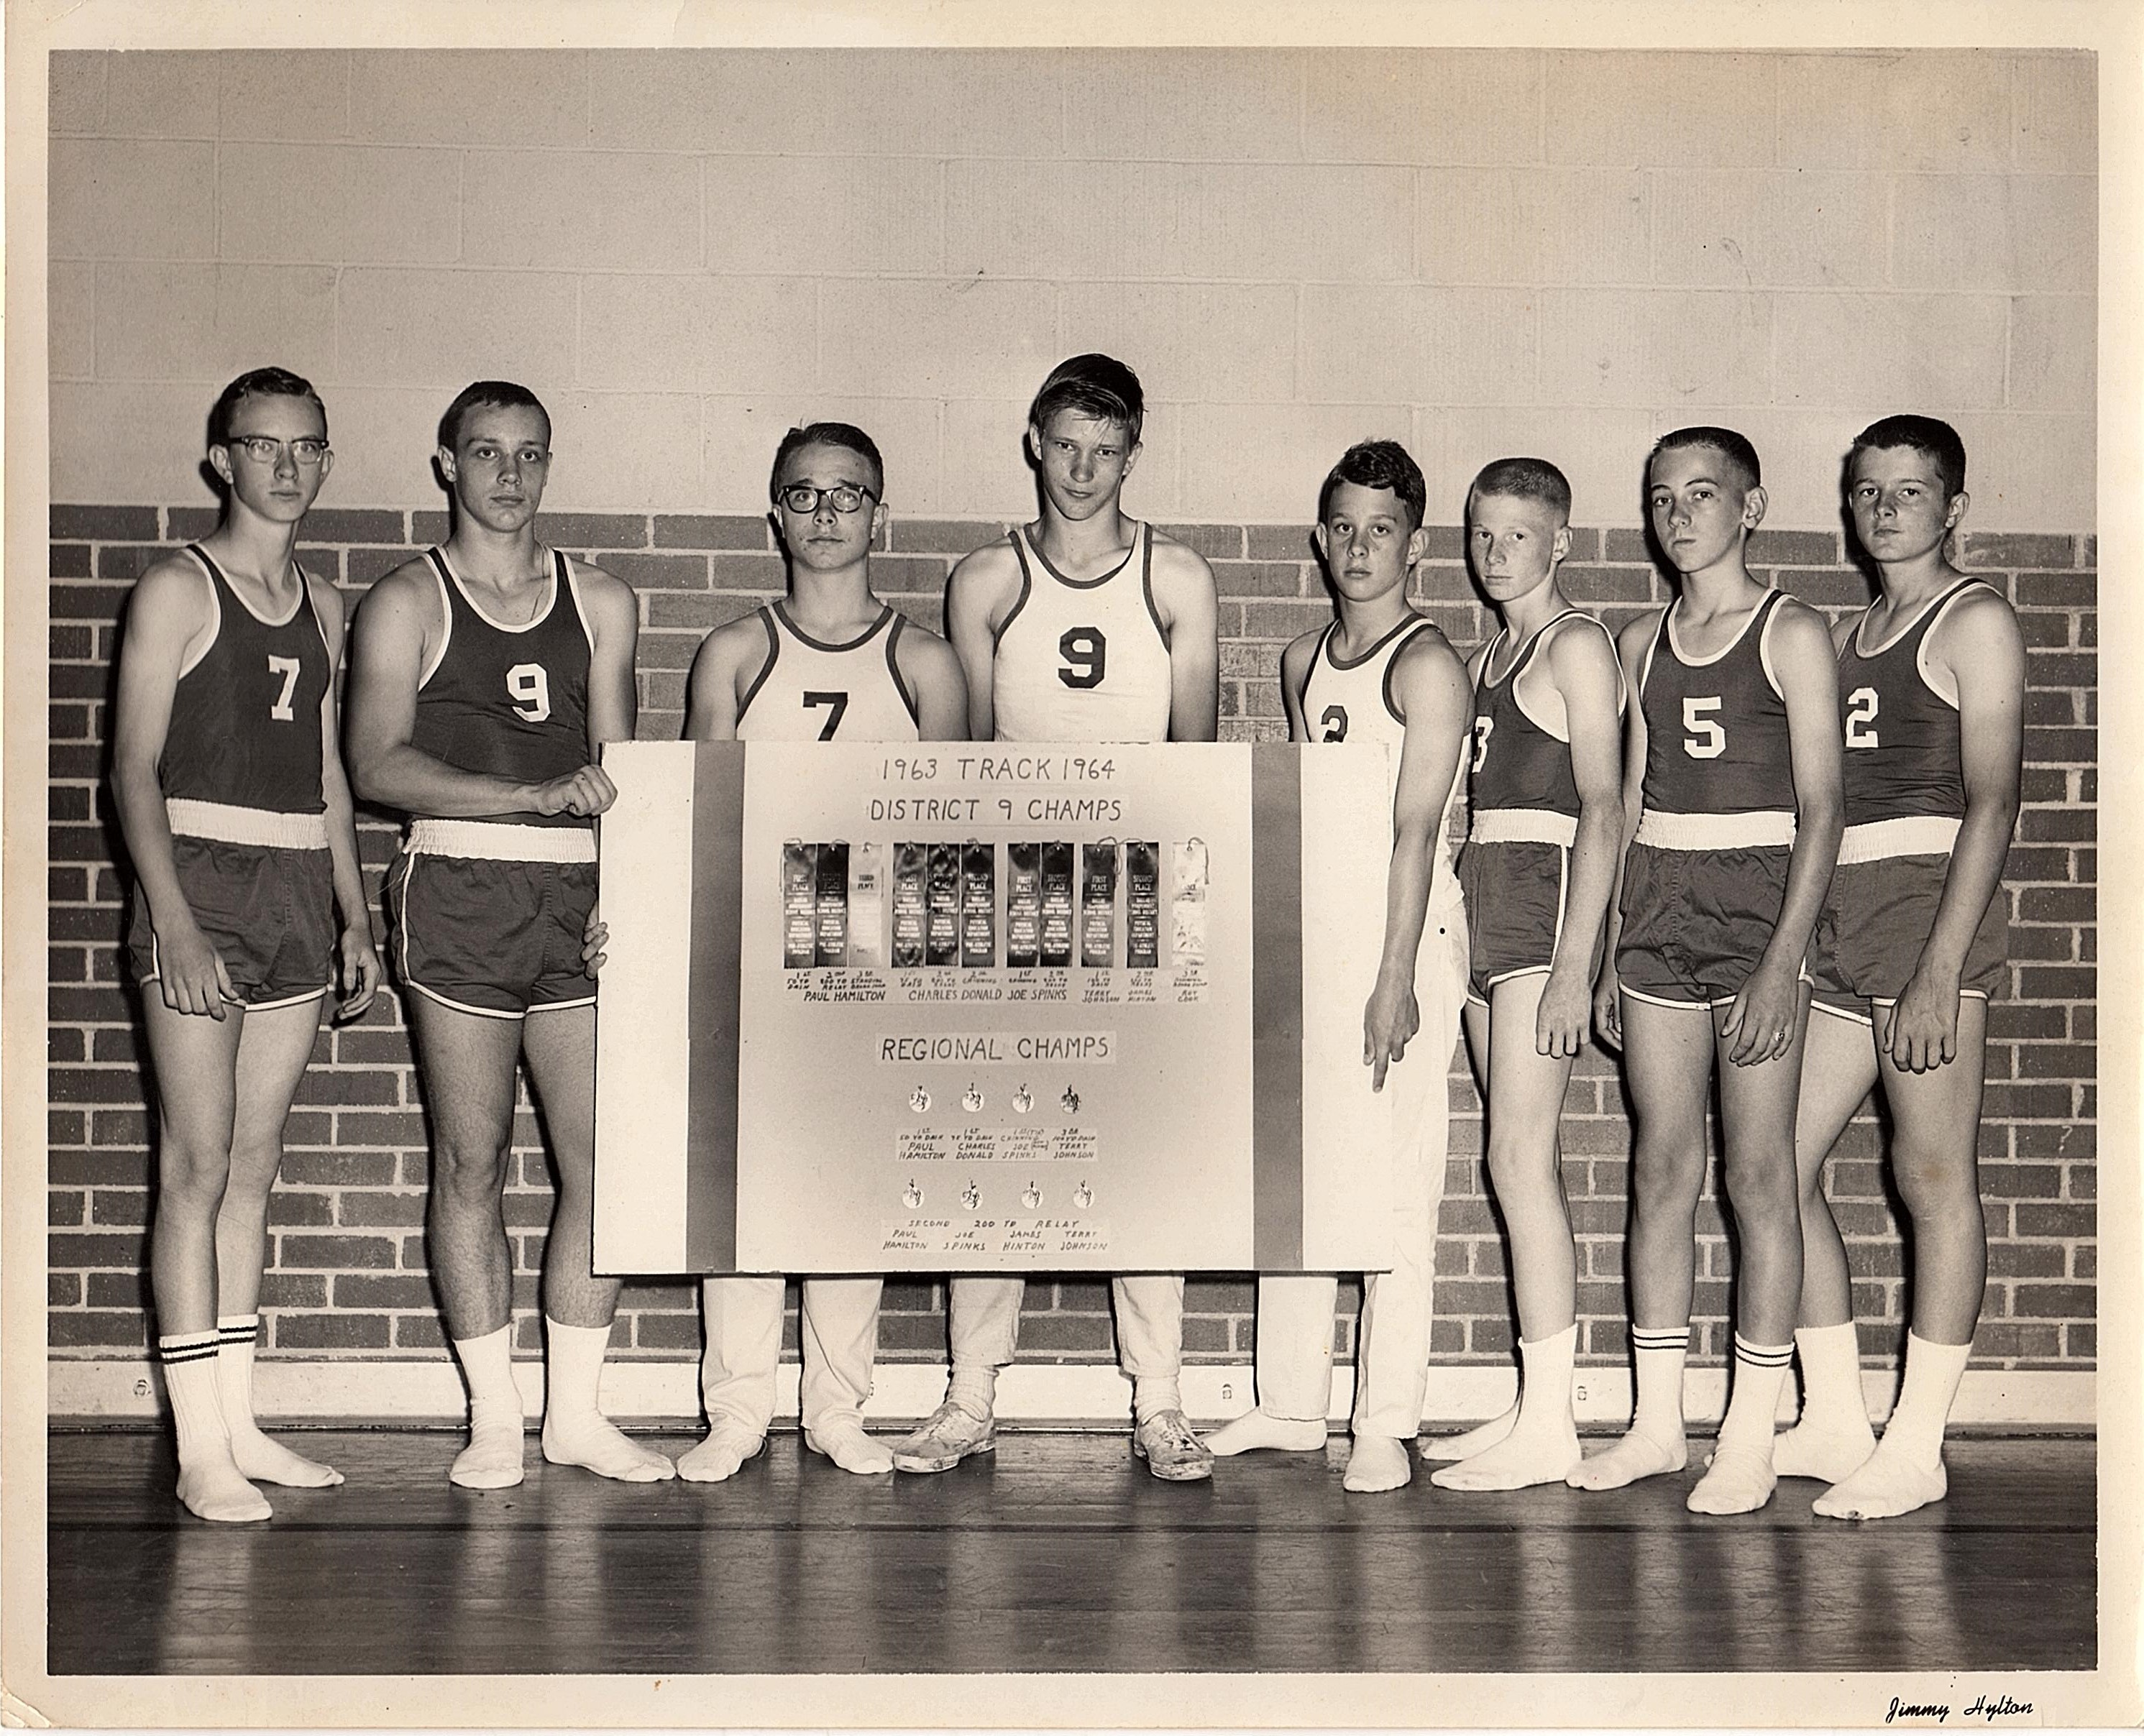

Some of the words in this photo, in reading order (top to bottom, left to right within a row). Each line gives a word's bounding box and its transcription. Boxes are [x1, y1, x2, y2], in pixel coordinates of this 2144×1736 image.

[1058, 627, 1107, 689] 9
[268, 655, 300, 720] 7
[507, 663, 551, 722] 9
[803, 692, 848, 741] 7
[1846, 687, 1879, 748] 2
[1683, 696, 1726, 758] 5
[1472, 716, 1494, 773] 3
[883, 758, 938, 781] 1963
[958, 758, 1051, 781] TRACK
[1064, 758, 1116, 780] 1964
[871, 799, 981, 821] DISTRICT
[998, 799, 1012, 821] 9
[1027, 799, 1122, 821] CHAMPS
[804, 991, 829, 1001] PAUL
[834, 991, 886, 1001] HAMILTON
[908, 989, 958, 1001] CHARLES
[961, 989, 1003, 1000] DONALD
[1007, 989, 1027, 1000] JOE
[1030, 989, 1068, 1000] SPINKS
[881, 1038, 1003, 1060] REGIONAL
[1017, 1037, 1109, 1059] CHAMPS
[908, 1142, 935, 1151] PAUL
[958, 1142, 997, 1151] CHARLES
[1035, 1220, 1080, 1228] RELAY
[892, 1229, 918, 1238] PAUL
[882, 1241, 928, 1250] HAMILTON
[943, 1242, 986, 1251] SPINKS
[1002, 1241, 1045, 1251] HINTON
[1060, 1241, 1108, 1251] JOHNSON
